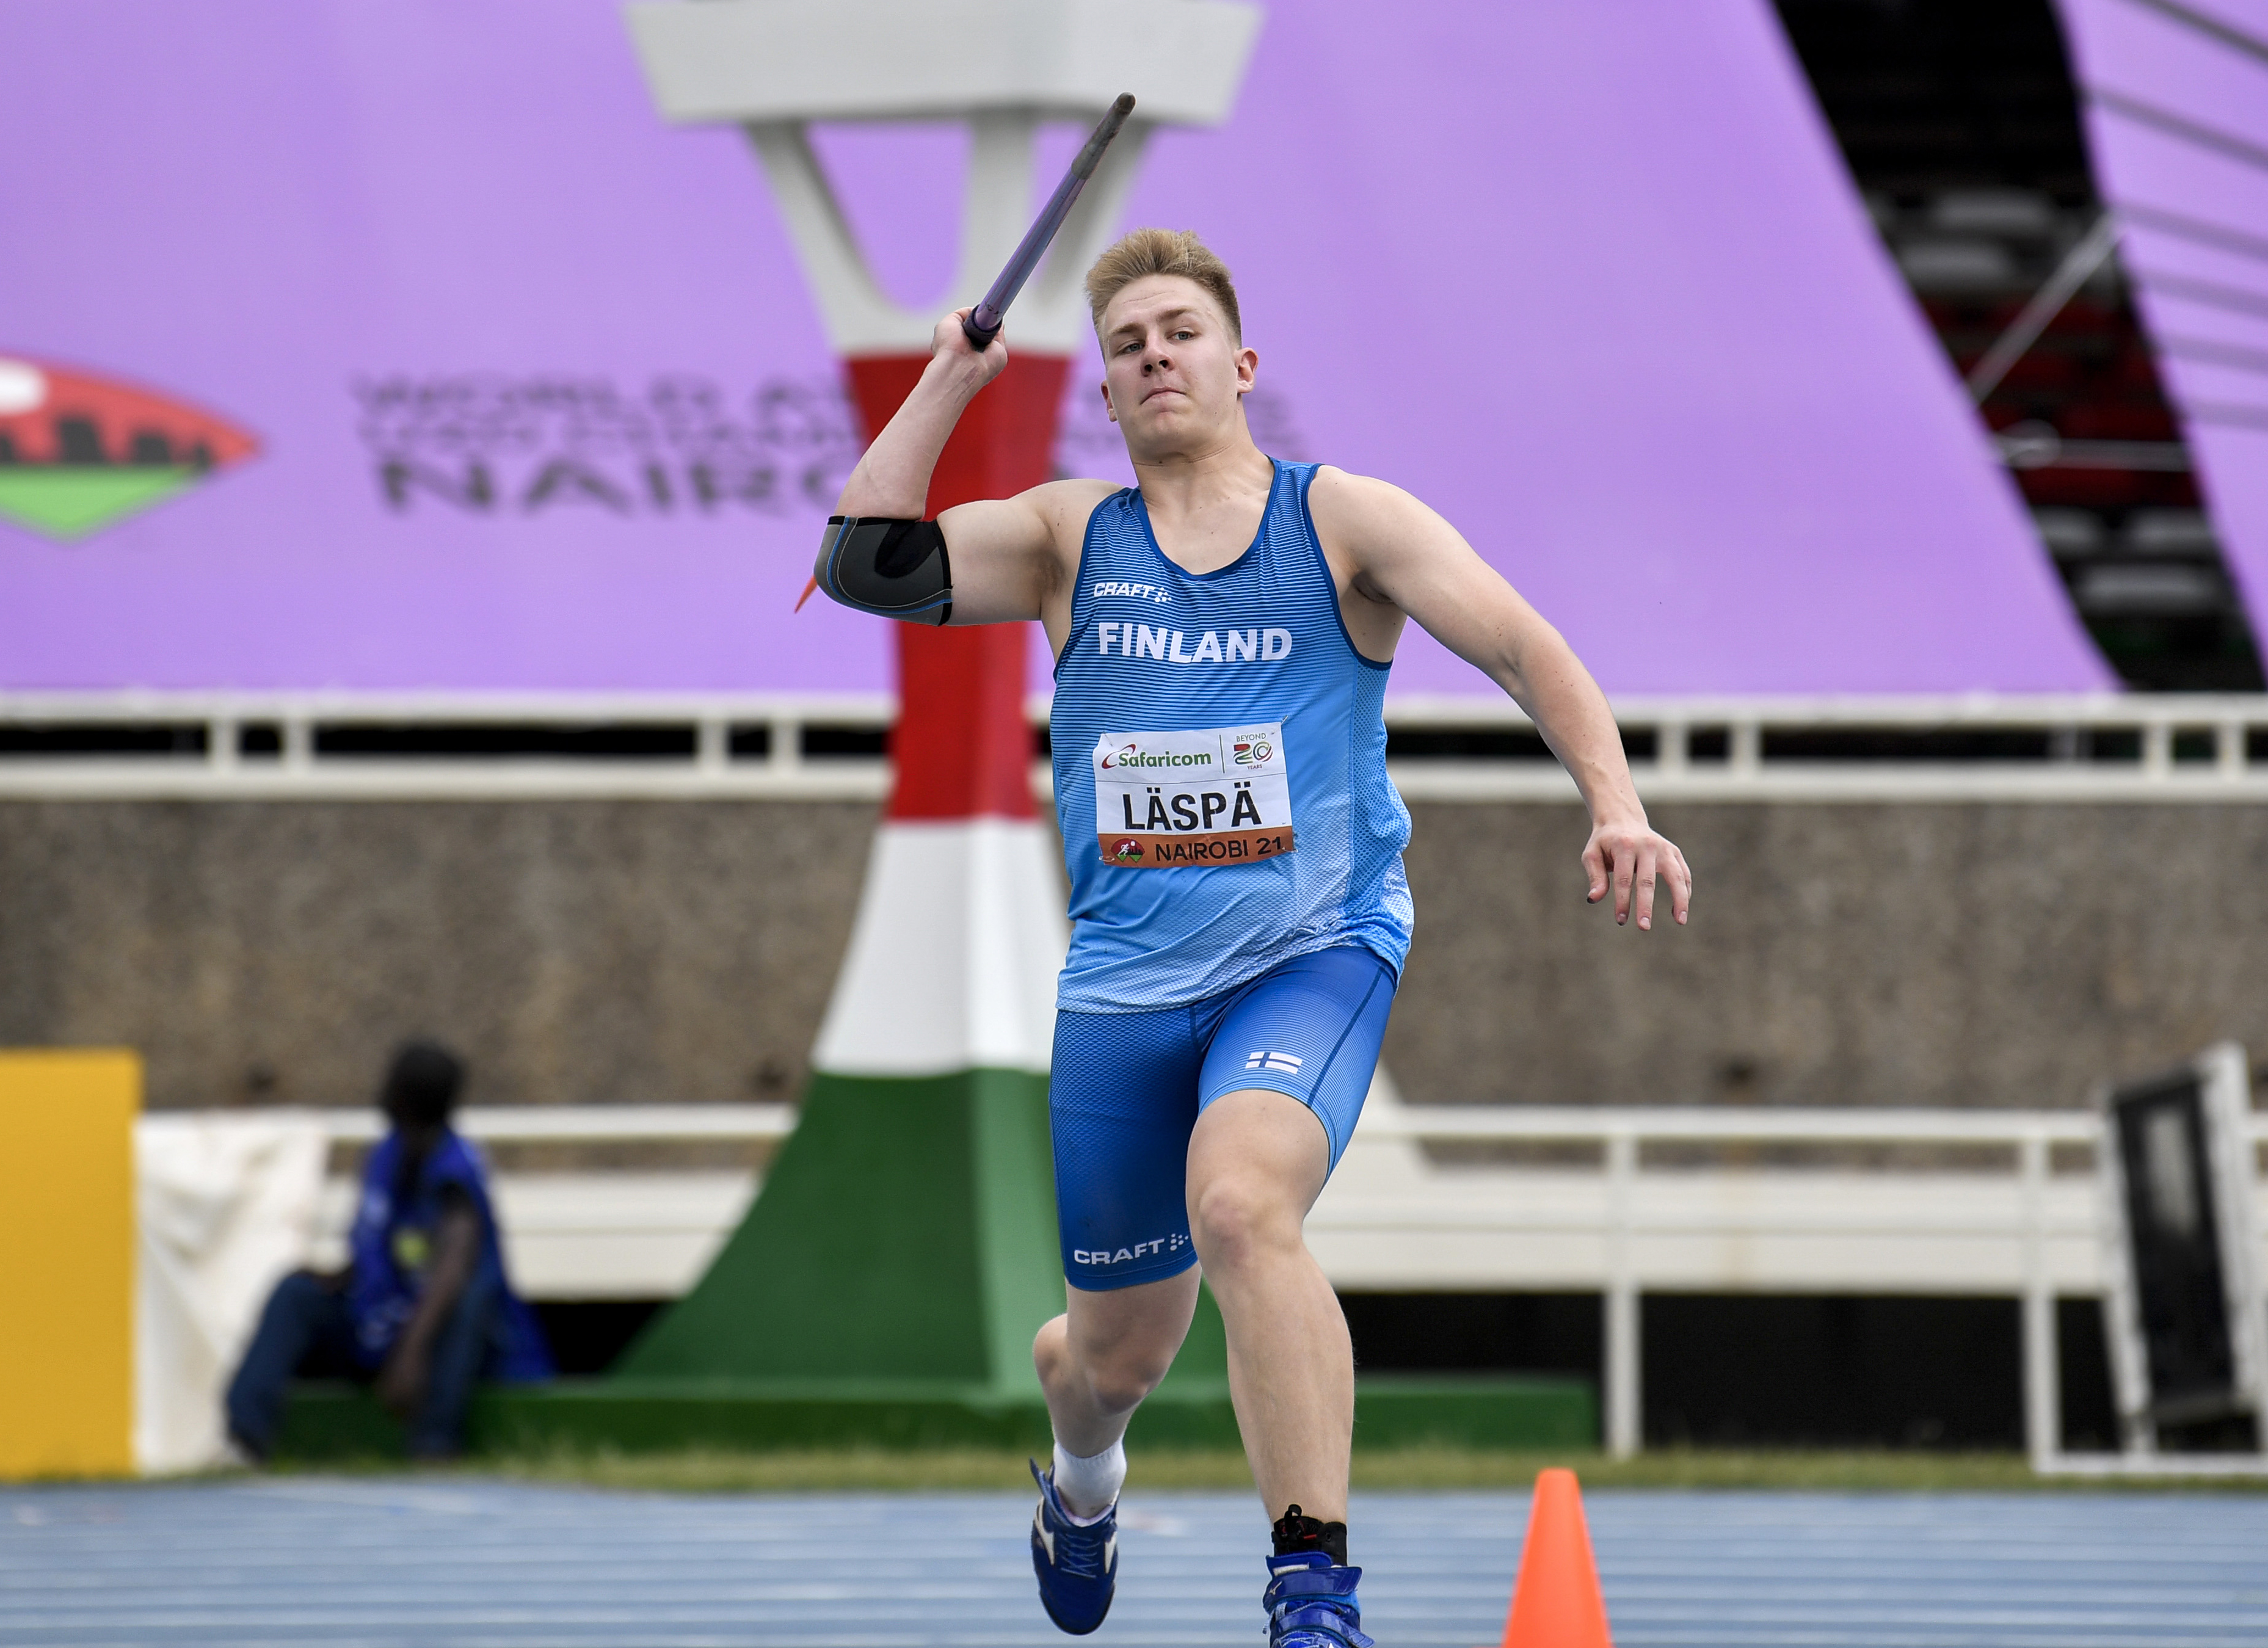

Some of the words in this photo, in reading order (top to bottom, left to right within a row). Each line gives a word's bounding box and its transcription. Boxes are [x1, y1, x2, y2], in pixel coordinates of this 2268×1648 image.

[371, 453, 855, 518] NAIRO
[1094, 583, 1155, 598] CRAFT
[1099, 622, 1293, 663] FINLAND
[1236, 733, 1267, 742] BEYOND
[1118, 751, 1212, 768] Safaricom
[1233, 741, 1273, 765] 20
[1122, 781, 1262, 832] LÄSPÄ
[1155, 839, 1249, 862] NAIROBI
[1256, 836, 1282, 855] 21
[1074, 1238, 1165, 1265] CRAFT
